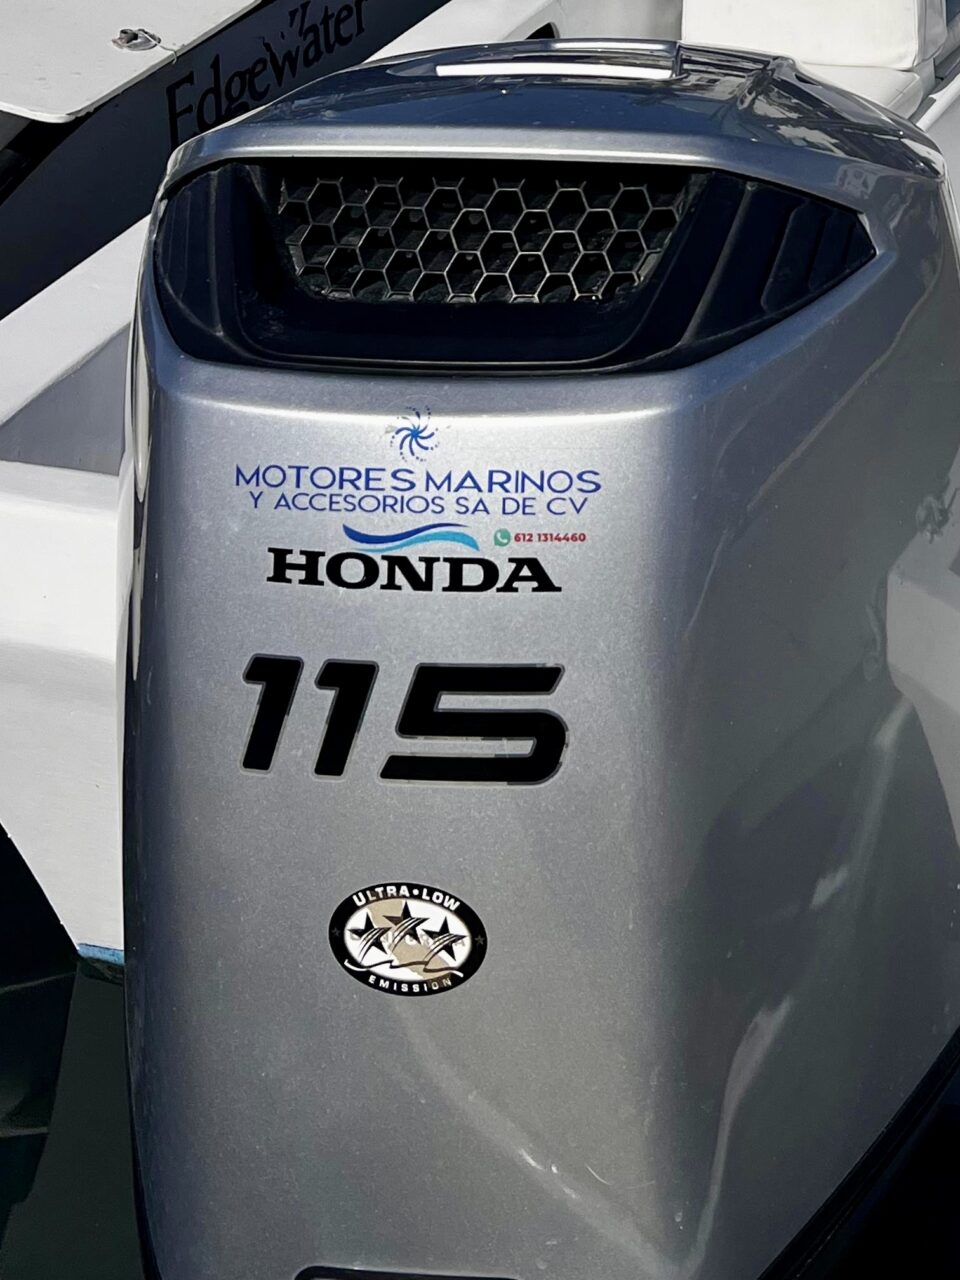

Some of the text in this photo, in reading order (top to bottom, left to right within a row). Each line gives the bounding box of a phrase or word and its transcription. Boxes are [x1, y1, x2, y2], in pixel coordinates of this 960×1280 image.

[235, 464, 602, 494] MOTORES MARINOS
[249, 491, 589, 516] Y ACCESORIOS SA DE CV
[513, 532, 587, 543] 612 1314460
[266, 547, 562, 593] HONDA
[241, 653, 568, 786] 115
[352, 885, 461, 911] ULTRA LOW
[368, 975, 452, 993] EMISSION
